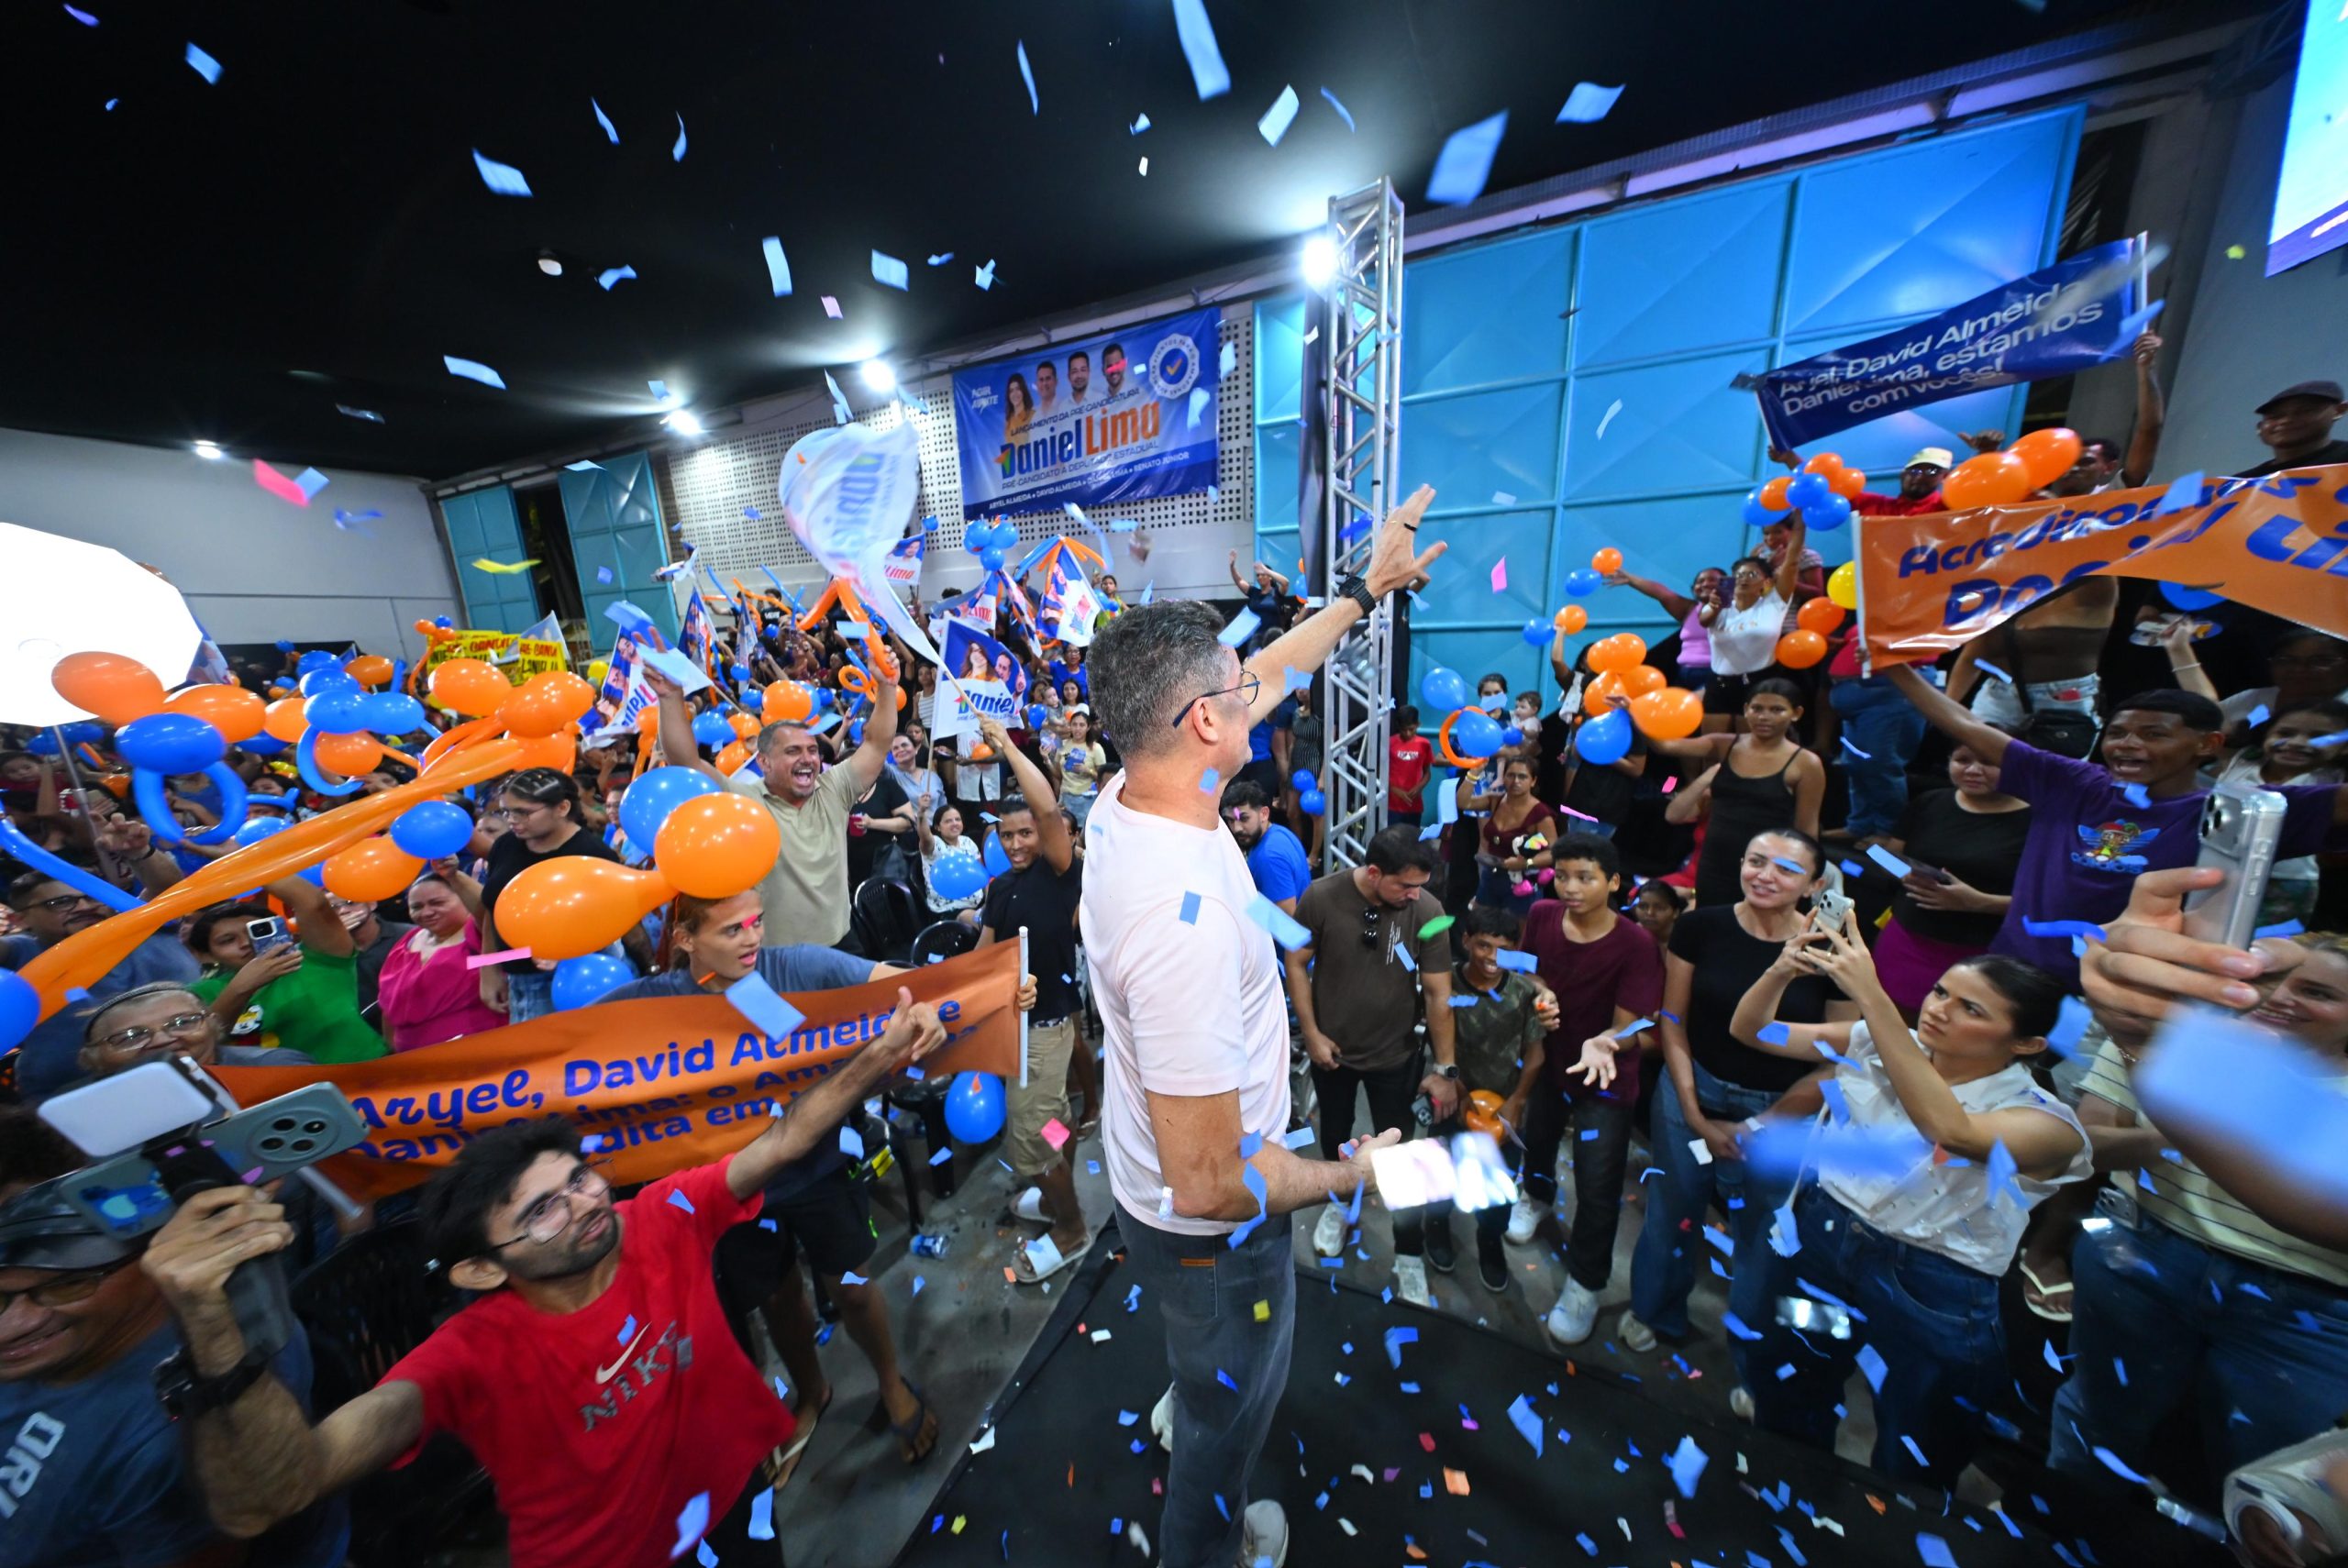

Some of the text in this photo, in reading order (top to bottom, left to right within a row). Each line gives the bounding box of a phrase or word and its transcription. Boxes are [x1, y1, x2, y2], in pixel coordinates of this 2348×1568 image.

[1846, 336, 1933, 380] David
[1934, 281, 2080, 350] Almeid
[1935, 301, 2103, 372] estamos
[1848, 358, 2005, 414] com vocês!
[997, 401, 1160, 480] Daniel Lima
[1113, 440, 1158, 460] ESTADUAL
[563, 1038, 714, 1098] David
[730, 1007, 897, 1067] Almeid
[938, 1000, 961, 1022] e
